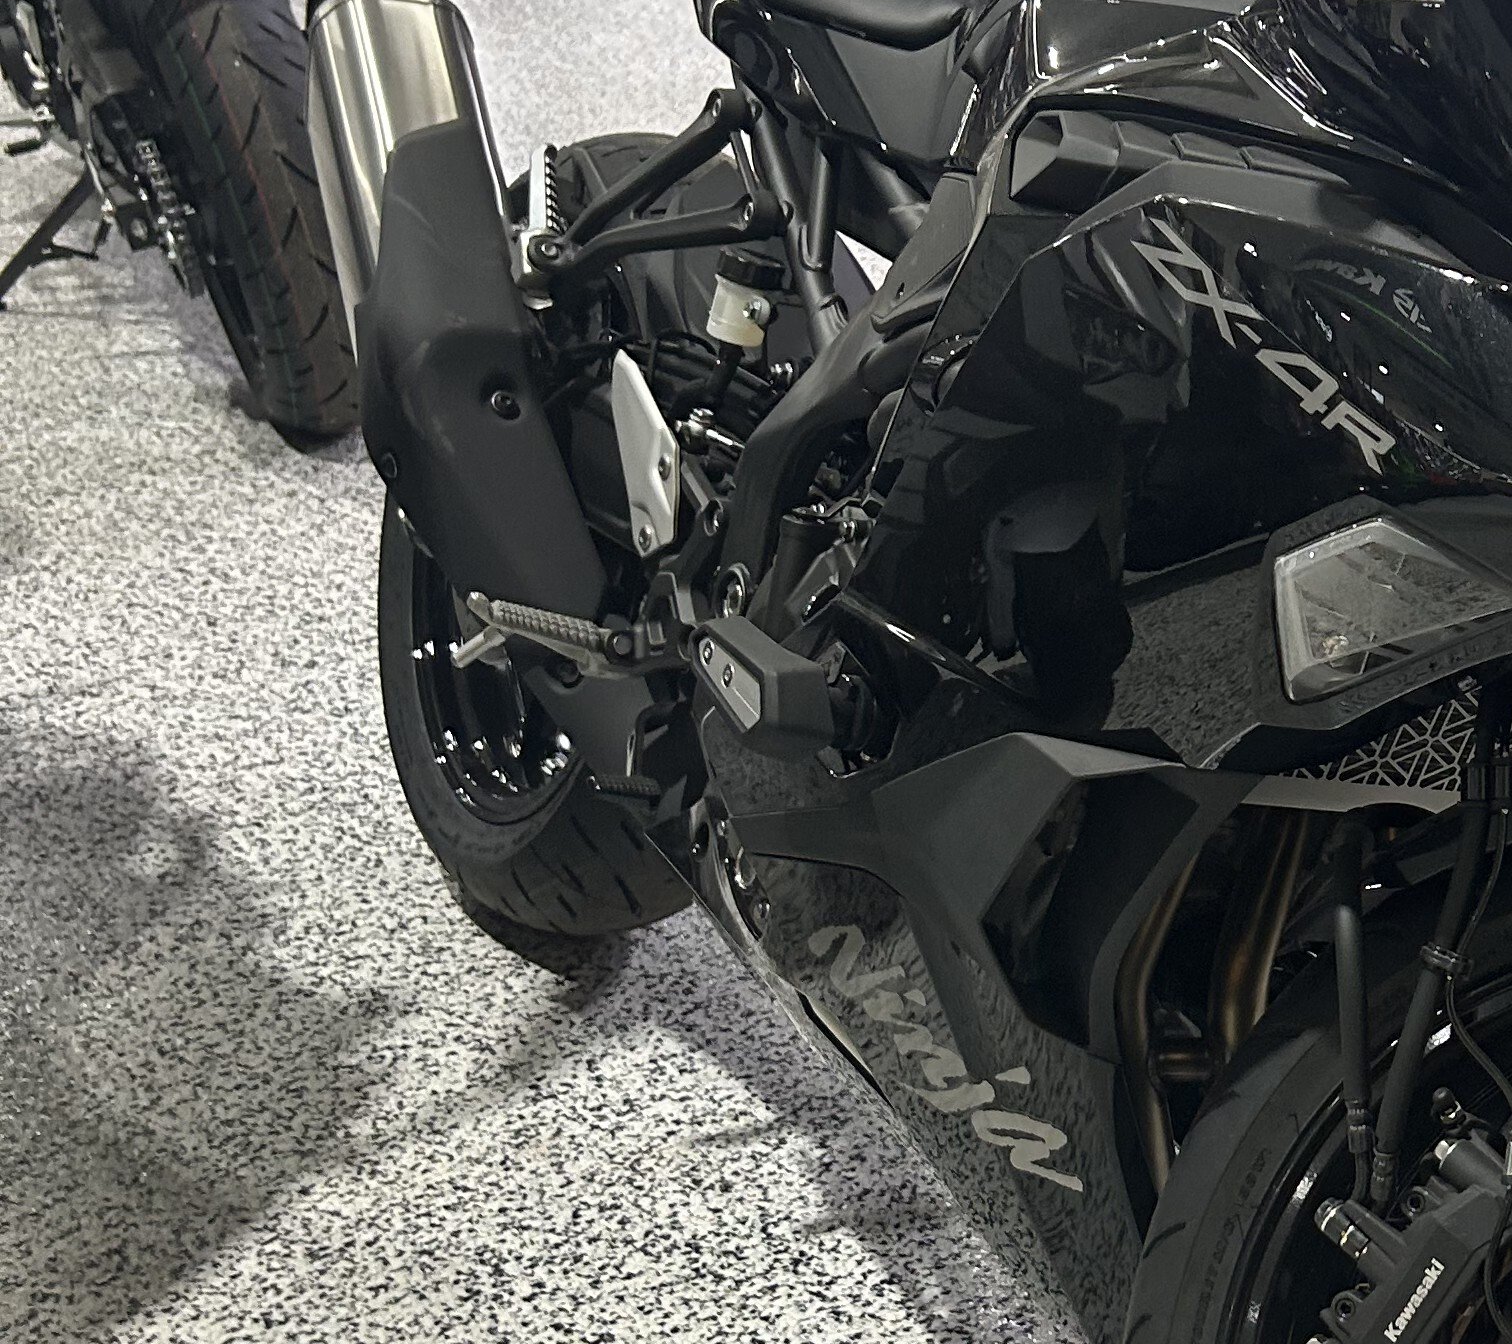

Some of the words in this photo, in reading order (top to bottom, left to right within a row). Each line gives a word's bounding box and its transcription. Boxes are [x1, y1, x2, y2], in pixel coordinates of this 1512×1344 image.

[1130, 216, 1397, 476] ZX-4R
[807, 923, 1084, 1192] Ninja
[1383, 1257, 1446, 1344] Kawasaki
